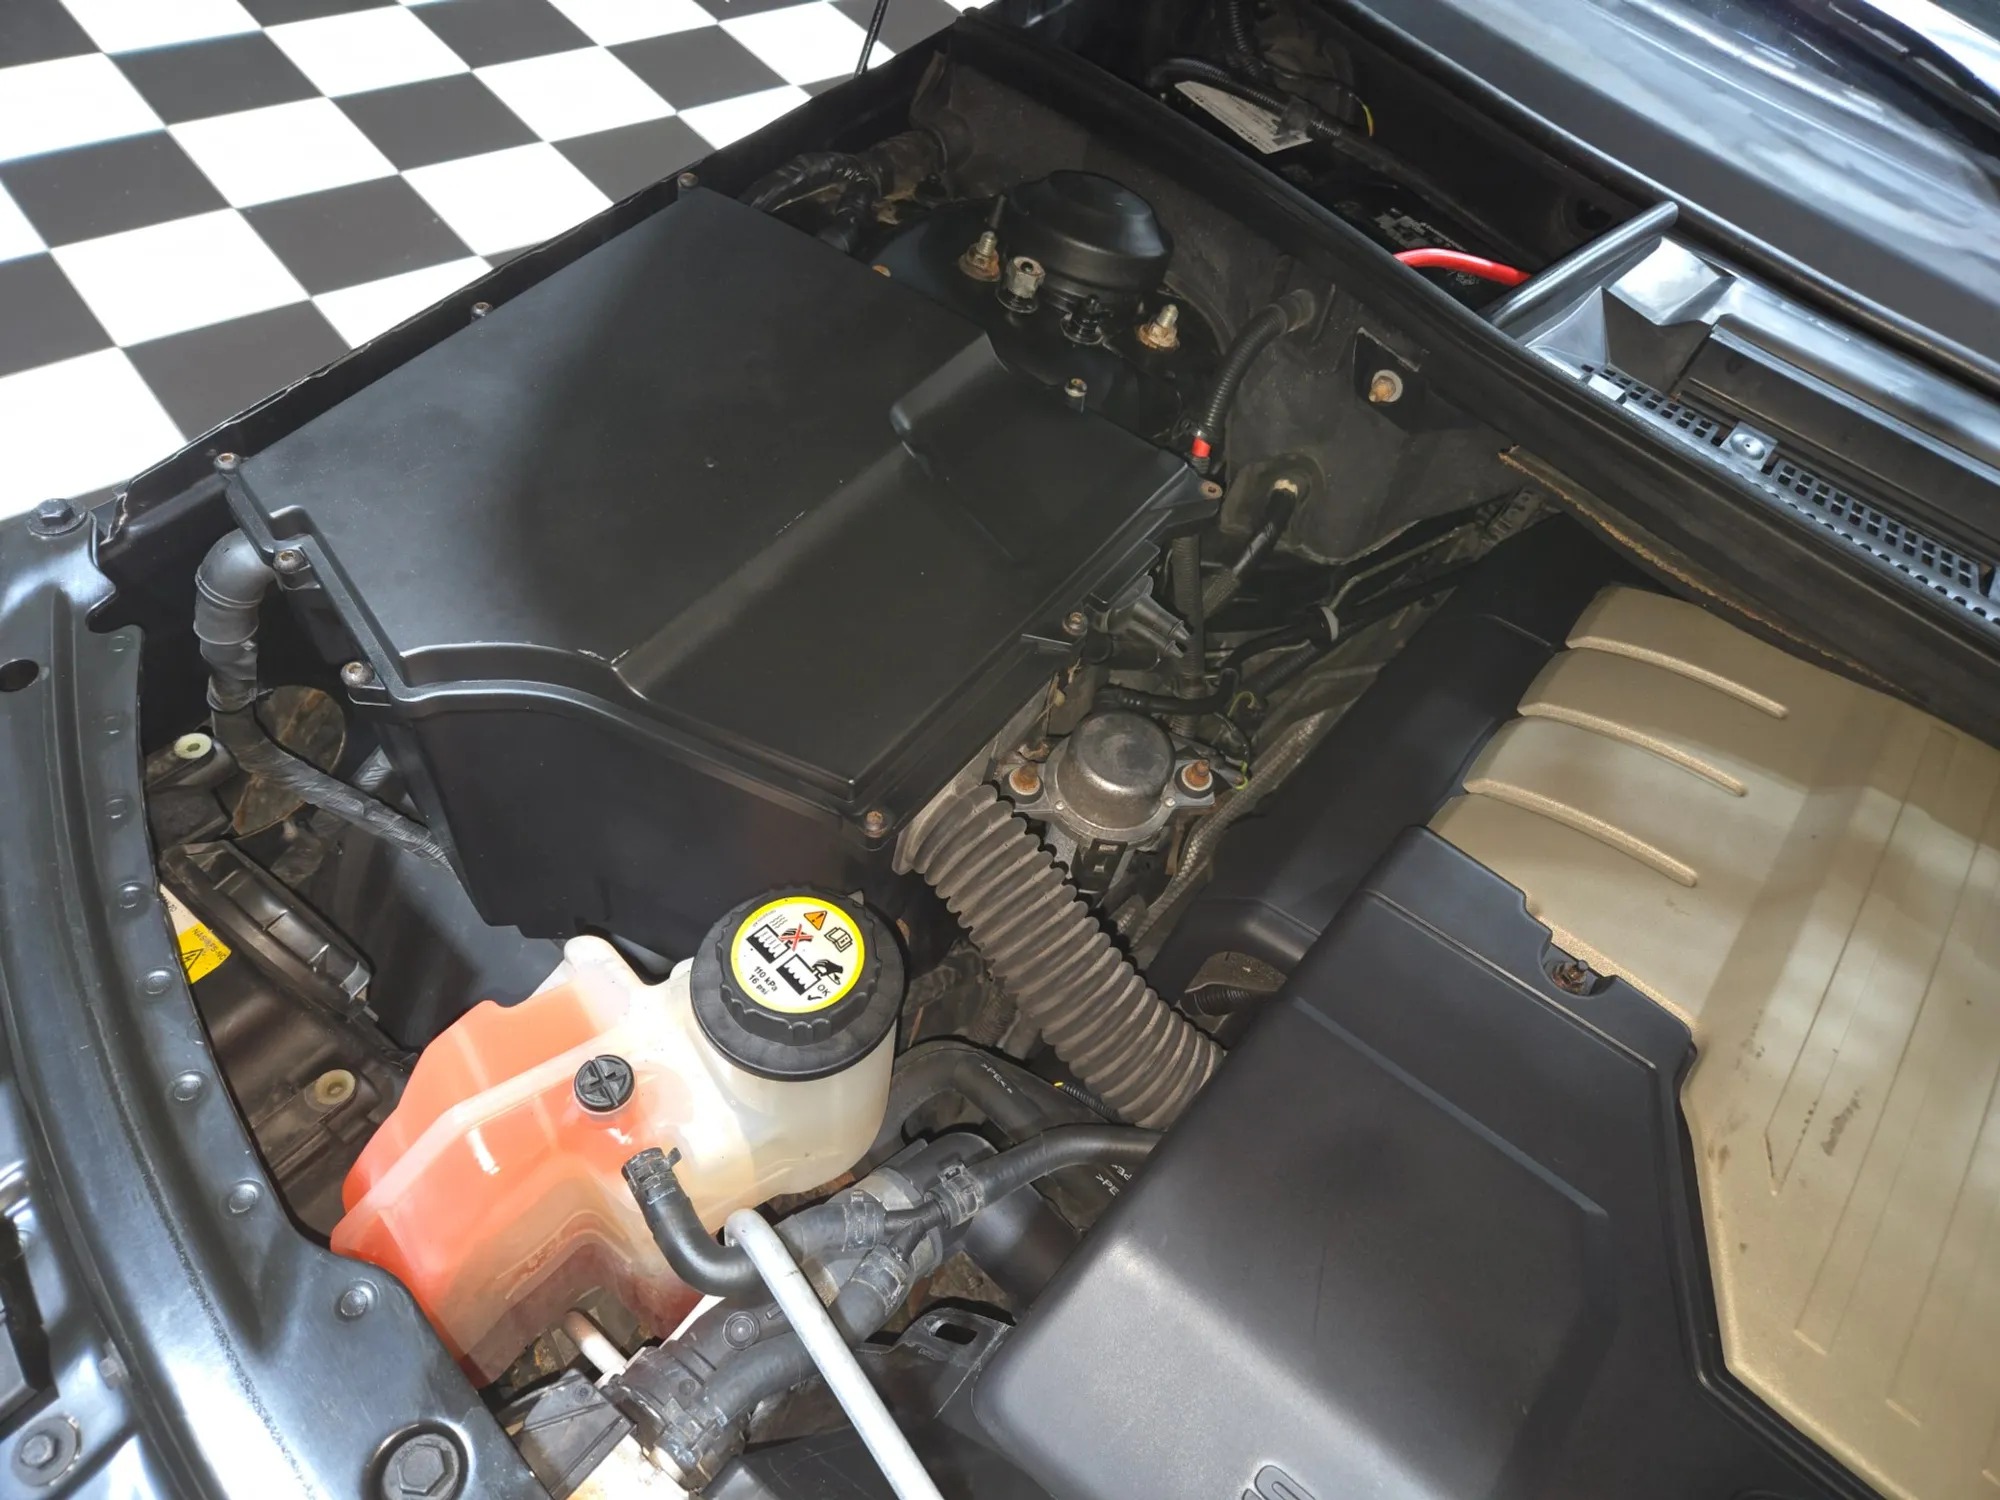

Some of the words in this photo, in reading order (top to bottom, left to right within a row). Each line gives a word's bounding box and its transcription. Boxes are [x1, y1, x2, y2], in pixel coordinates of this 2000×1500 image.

[749, 974, 759, 984] 16
[756, 984, 769, 995] psi
[754, 966, 766, 978] 110
[764, 976, 778, 991] kPa
[817, 984, 831, 997] OK
